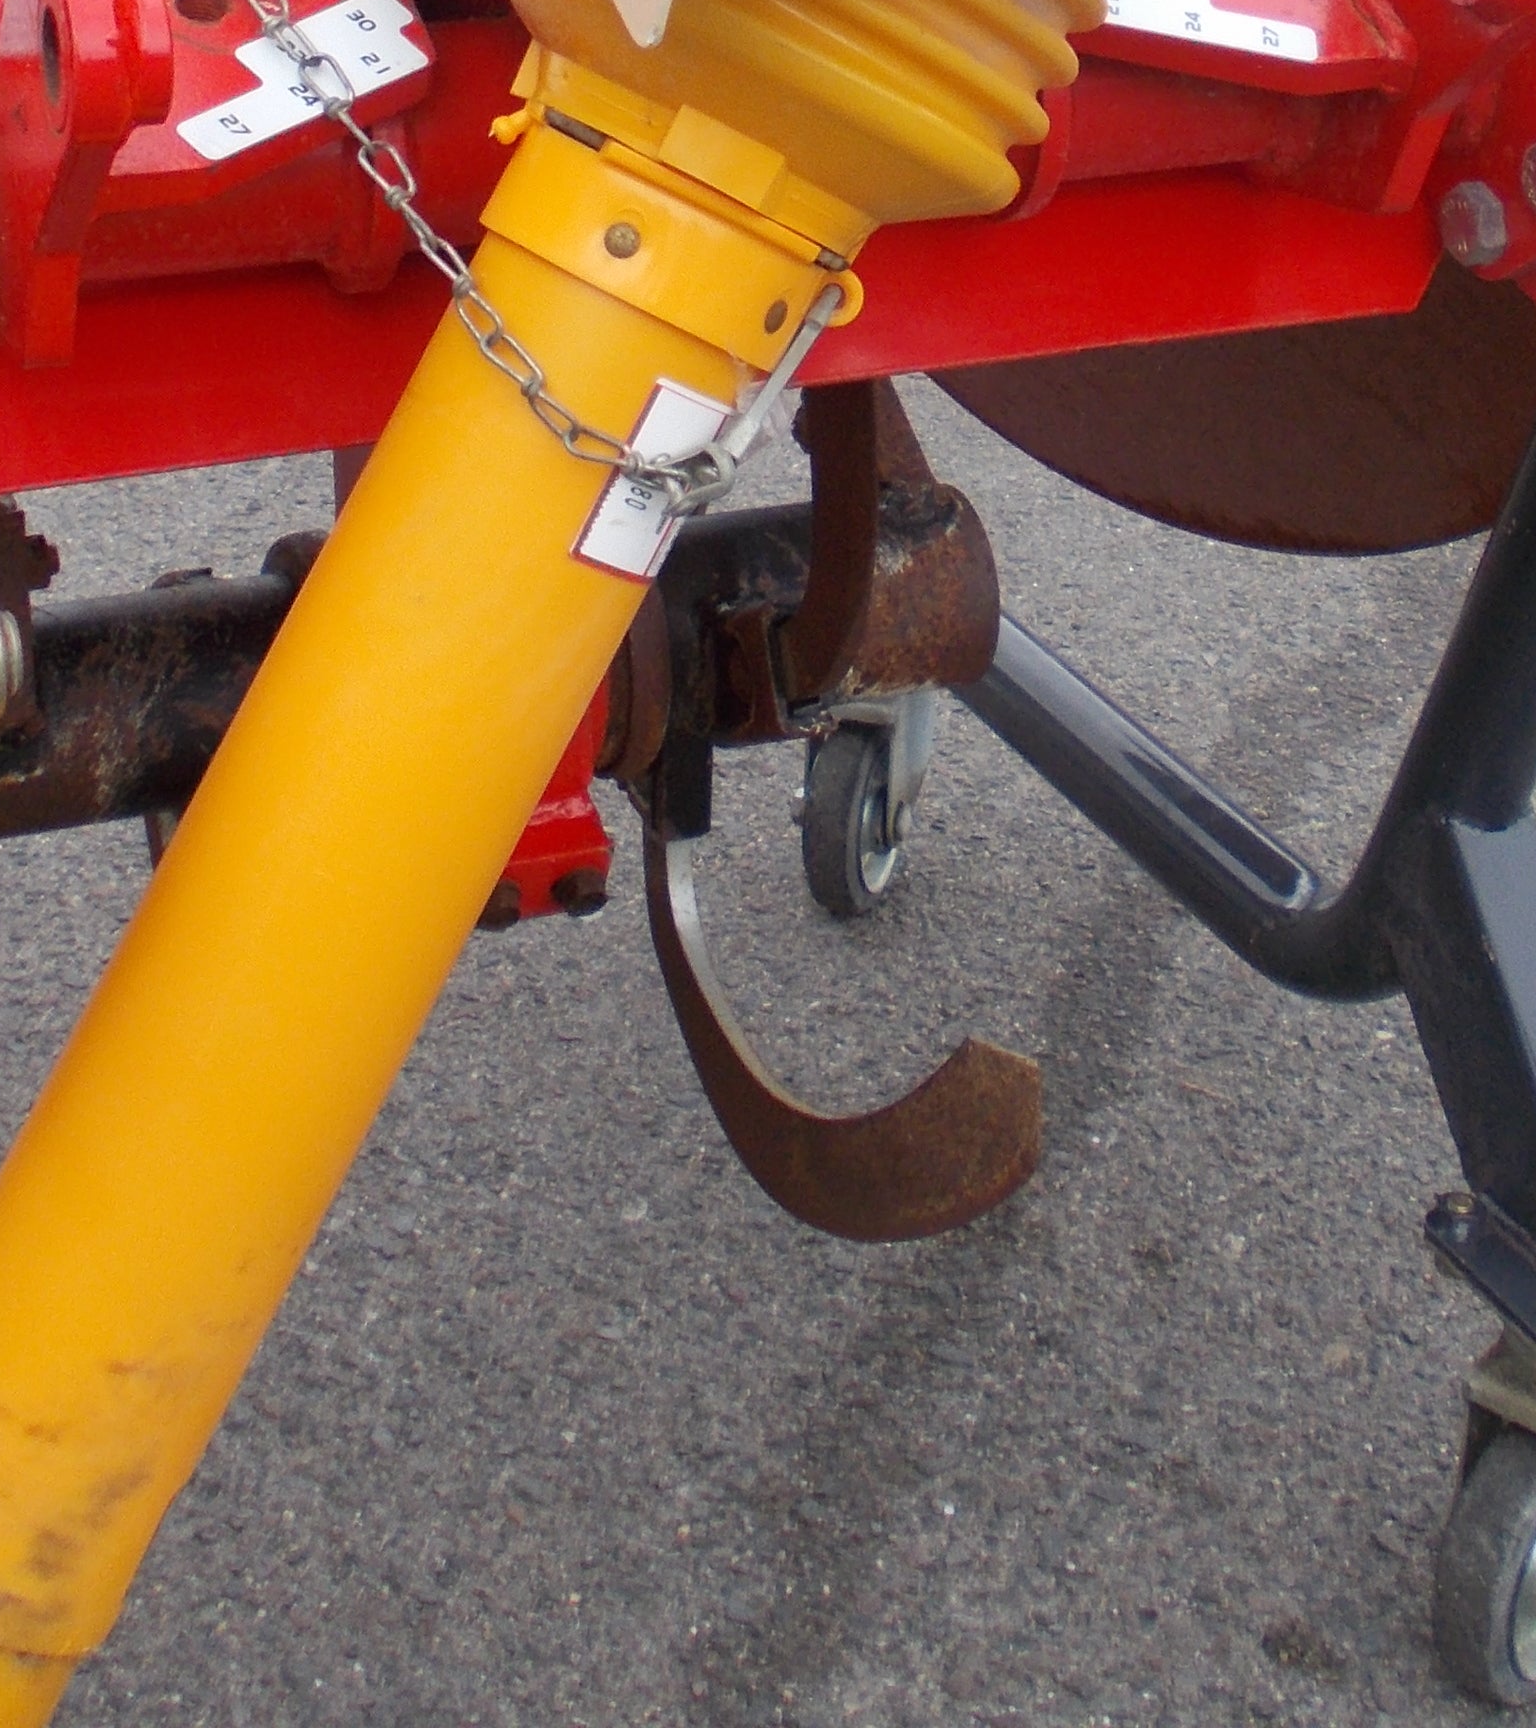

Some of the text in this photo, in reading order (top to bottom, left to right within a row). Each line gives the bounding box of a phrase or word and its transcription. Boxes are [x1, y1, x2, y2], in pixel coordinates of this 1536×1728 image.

[346, 9, 377, 32] 30
[1185, 11, 1201, 32] 24
[1262, 26, 1279, 47] 27
[360, 52, 391, 75] 21
[288, 84, 319, 107] 24
[219, 114, 252, 135] 27
